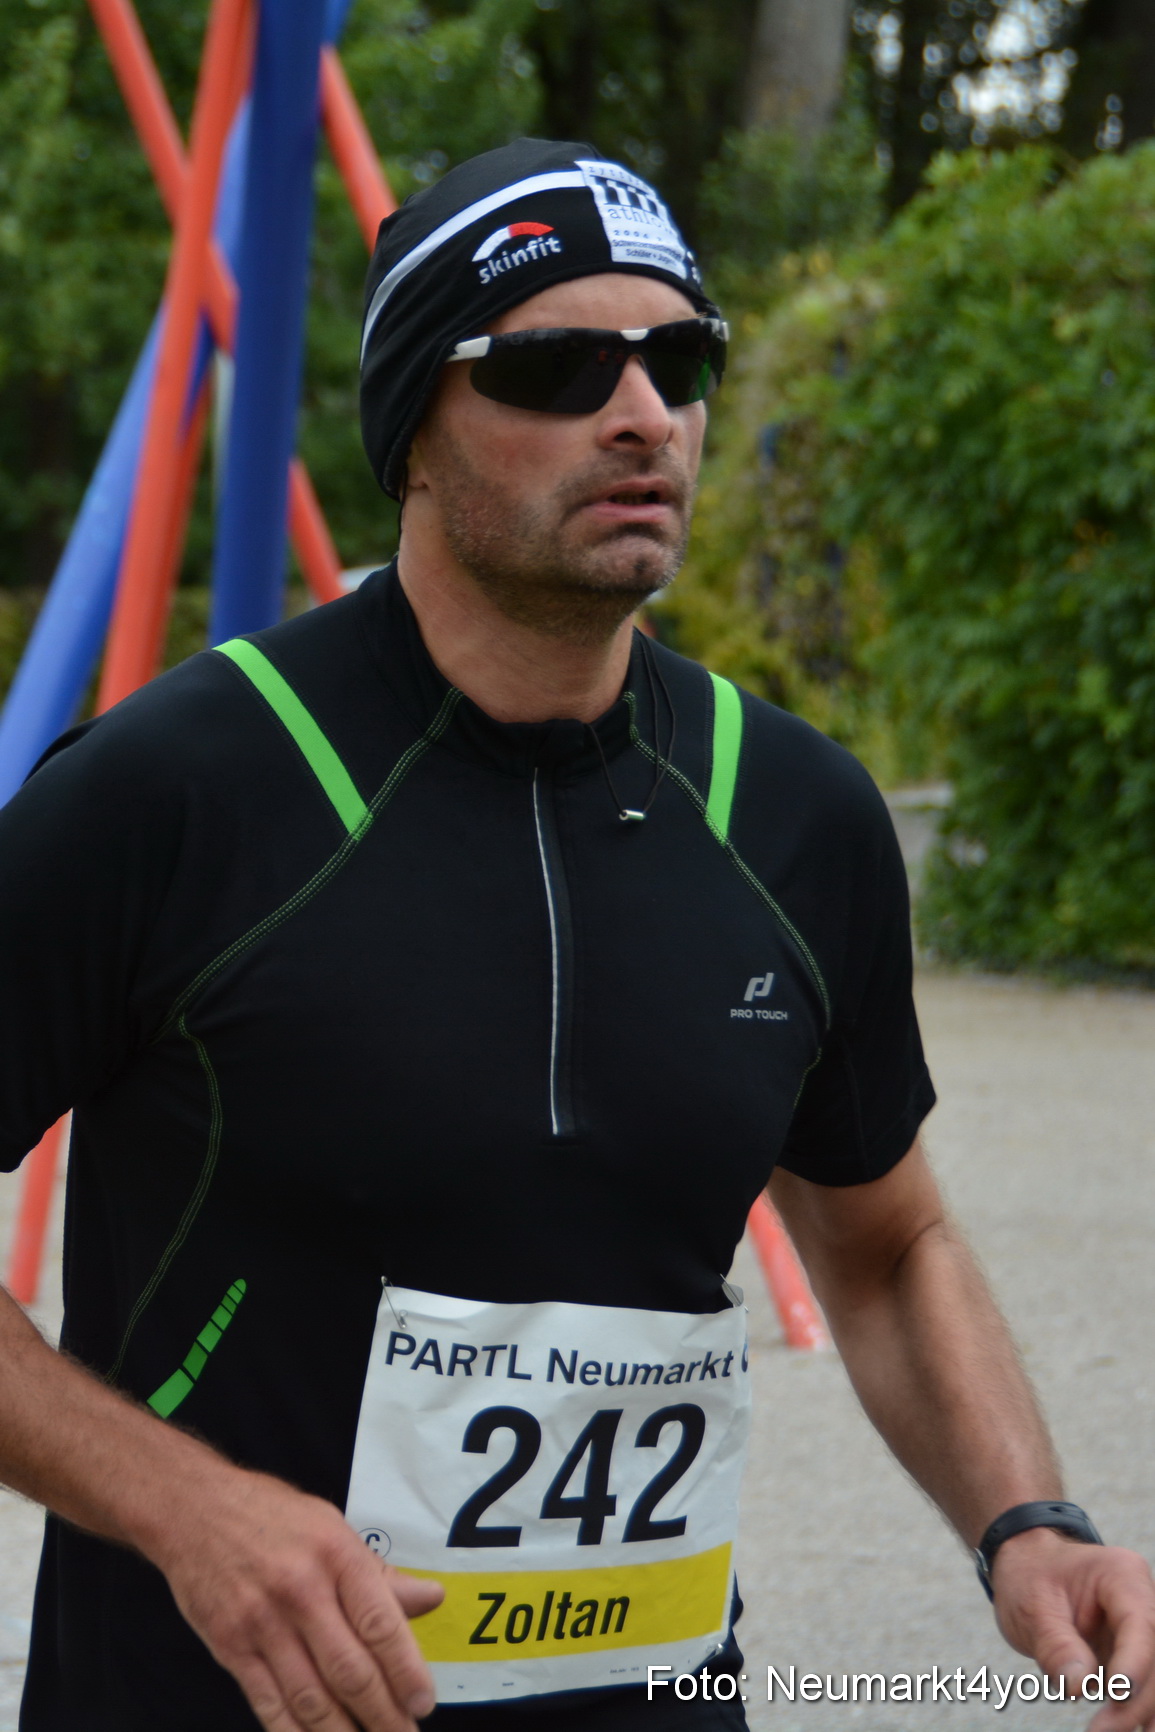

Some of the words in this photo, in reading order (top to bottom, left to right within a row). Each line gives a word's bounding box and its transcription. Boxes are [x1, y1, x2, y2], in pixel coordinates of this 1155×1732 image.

[478, 236, 562, 285] skinfit
[730, 1009, 754, 1019] PRO
[755, 1010, 788, 1021] TOUCH
[384, 1331, 532, 1381] PARTL
[546, 1348, 734, 1387] Neumarkt
[446, 1402, 706, 1549] 242
[468, 1590, 630, 1645] Zoltan
